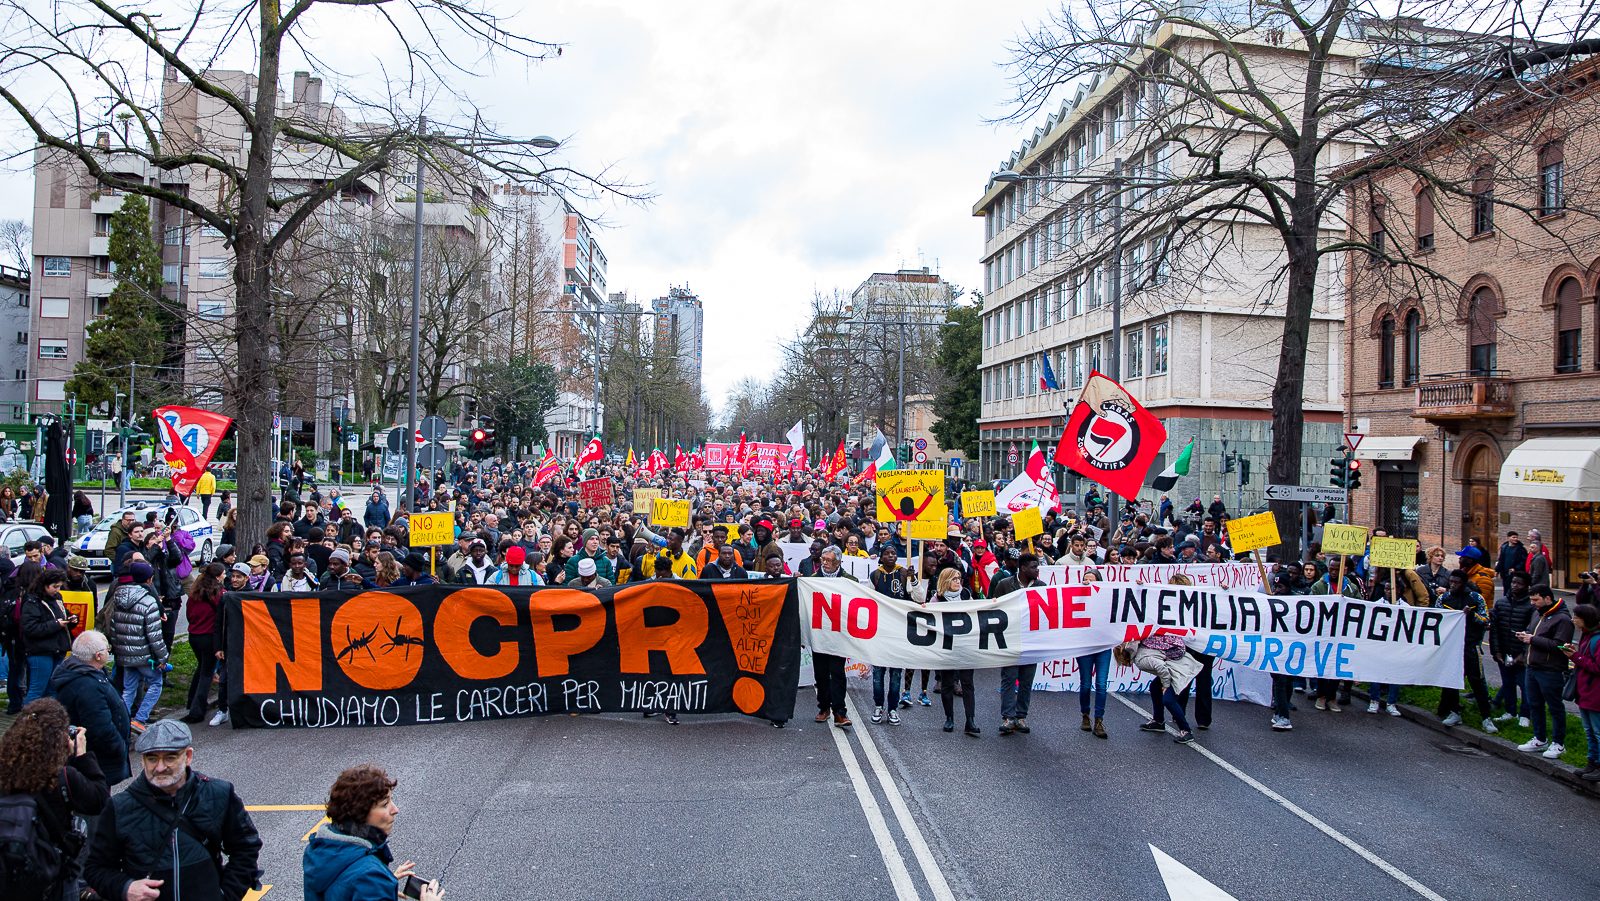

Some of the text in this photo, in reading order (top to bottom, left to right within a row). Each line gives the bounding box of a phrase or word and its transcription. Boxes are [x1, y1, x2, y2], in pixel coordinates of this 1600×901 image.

[1090, 459, 1126, 470] ANTIFA
[653, 501, 669, 521] NO
[413, 516, 433, 531] NO
[1373, 538, 1413, 552] FREEDOM
[735, 605, 761, 620] QUI
[811, 591, 879, 640] NO
[906, 609, 1009, 650] CPR
[1110, 588, 1148, 623] IN
[1157, 589, 1262, 632] EMILIA
[1269, 598, 1444, 646] ROMAGNA
[1204, 634, 1356, 679] ALTROVE
[260, 678, 709, 728] CHIUDIAMO LE CARCERI PER MIGRANTI
